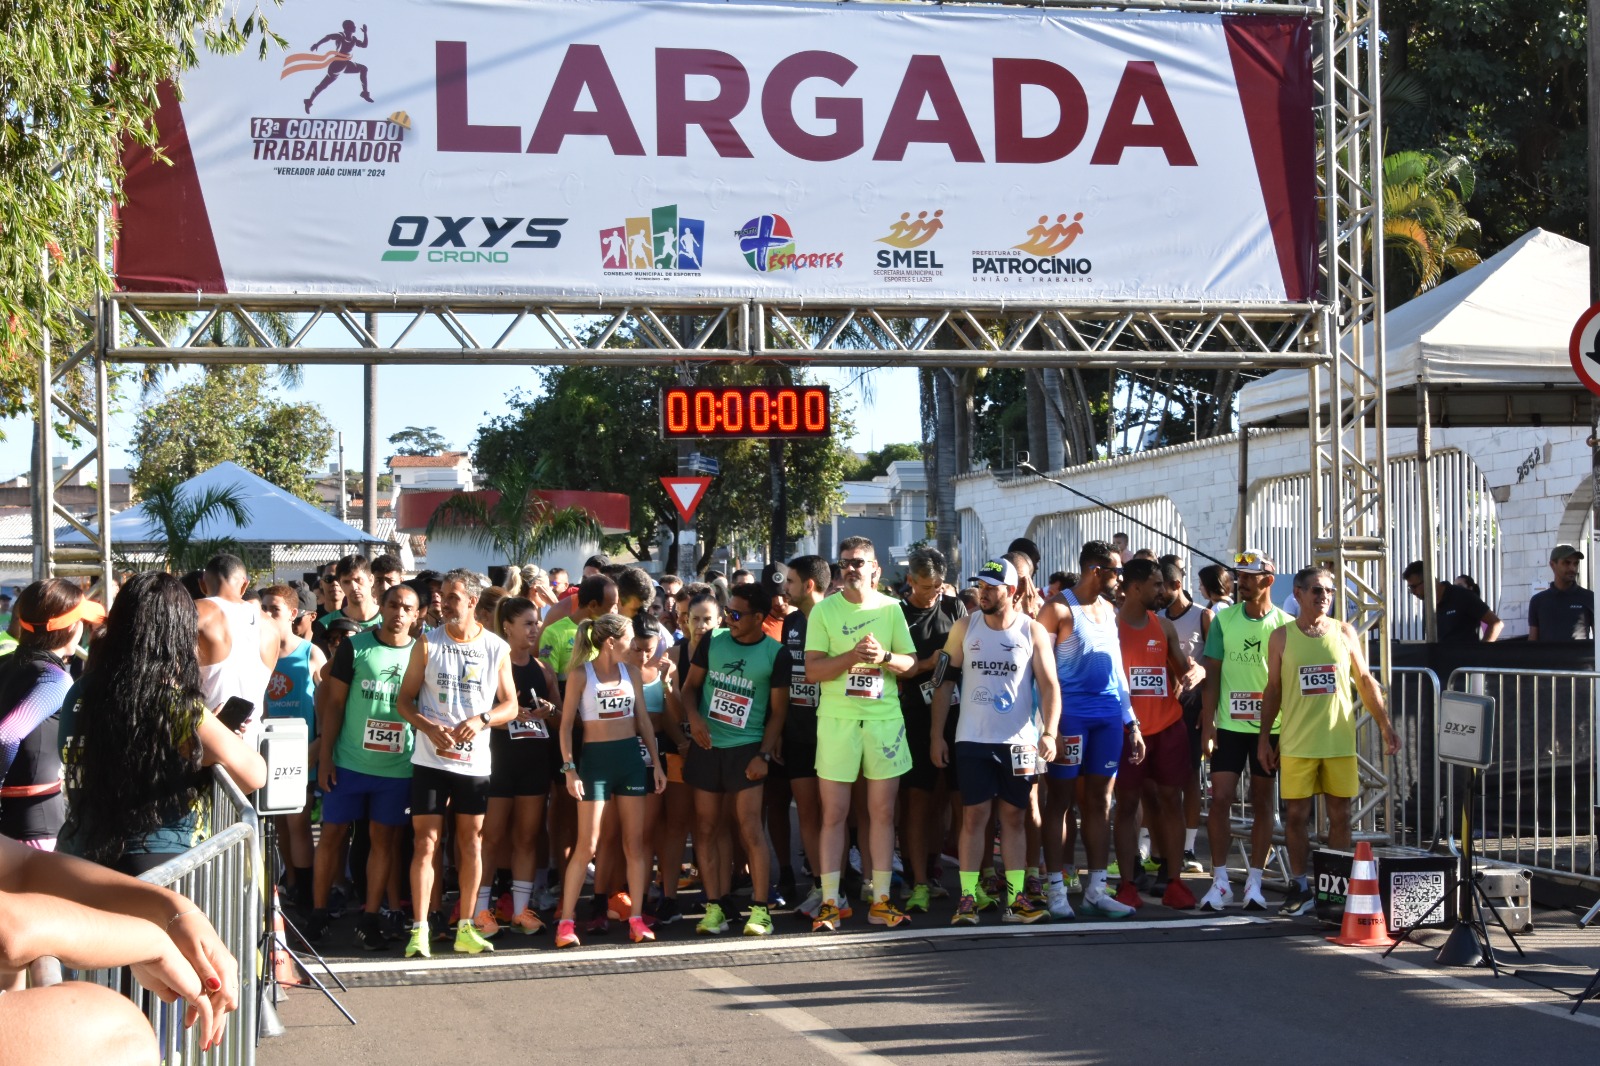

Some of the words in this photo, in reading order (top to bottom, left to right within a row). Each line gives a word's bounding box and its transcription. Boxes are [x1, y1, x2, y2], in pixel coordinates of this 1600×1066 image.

[436, 40, 1199, 166] LARGADA
[285, 119, 366, 140] CORRIDA
[374, 121, 400, 141] DO
[252, 139, 402, 163] TRABALHADOR
[317, 166, 335, 176] JOÃO
[367, 169, 386, 177] 2024
[387, 215, 569, 249] OXYS
[427, 250, 509, 263] CRONO
[769, 252, 844, 270] ESPORTES
[876, 249, 944, 269] SMEL
[972, 256, 1092, 275] PATROCÍNIO
[1229, 651, 1267, 663] CASAV
[971, 660, 1018, 672] PELOTÃO
[437, 672, 461, 681] CROSS
[713, 671, 753, 690] CORRIDA
[849, 675, 874, 687] 159
[1132, 676, 1163, 687] 1529
[1302, 673, 1336, 686] 1635
[369, 680, 401, 695] CORRI
[791, 684, 816, 697] 1546
[361, 689, 398, 703] TRABALH
[600, 696, 631, 710] 1475
[714, 698, 746, 717] 1556
[1231, 700, 1262, 711] 1518
[1445, 722, 1477, 734] OXYS
[368, 729, 400, 742] 1541
[455, 740, 473, 752] 93
[1064, 745, 1079, 756] 05
[274, 766, 302, 776] OXYS
[1318, 873, 1349, 896] OXY
